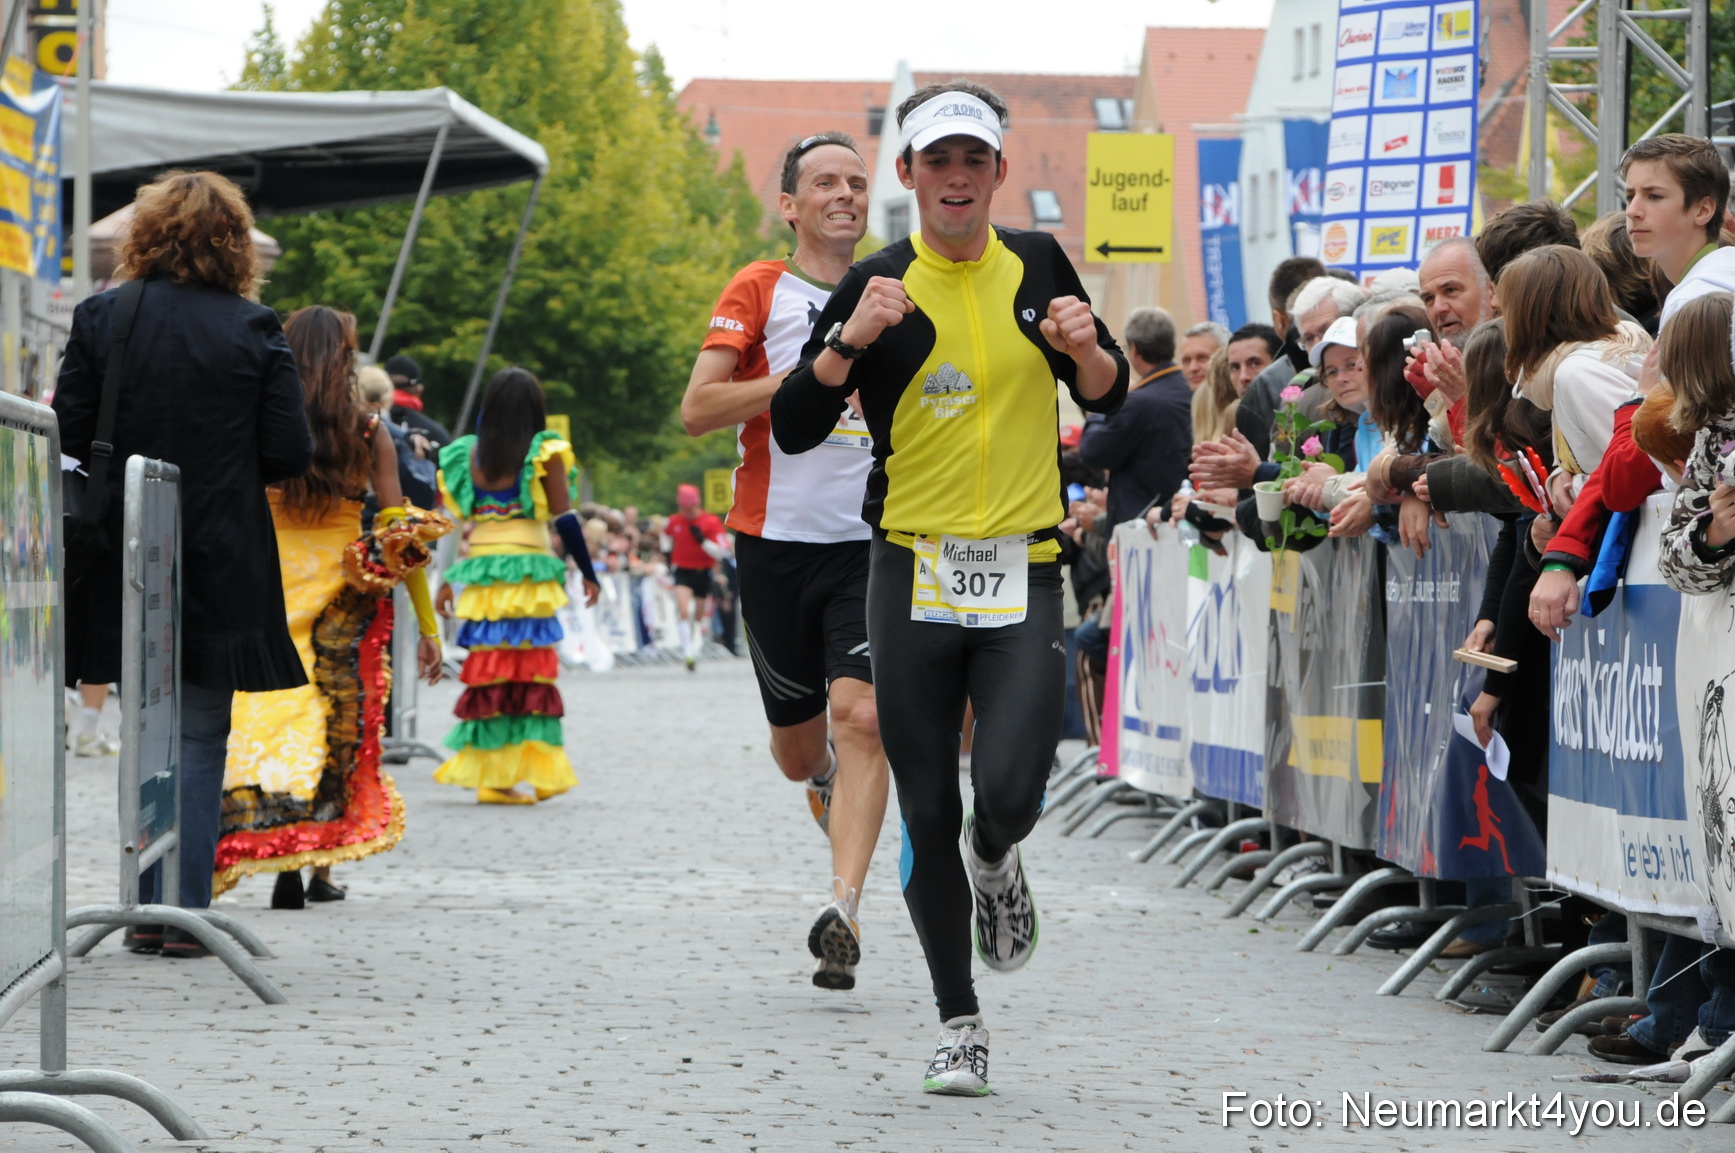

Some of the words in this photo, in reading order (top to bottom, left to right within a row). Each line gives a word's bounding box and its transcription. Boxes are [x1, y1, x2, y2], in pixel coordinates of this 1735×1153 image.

[1090, 168, 1170, 190] Jugend-
[1112, 193, 1149, 211] lauf
[1426, 226, 1461, 241] MERZ
[920, 394, 978, 410] Pyraser
[934, 406, 965, 419] Bier
[943, 542, 998, 562] Michael
[919, 562, 927, 575] A
[951, 570, 1006, 597] 307
[979, 612, 1024, 622] PFLEIDERER
[1668, 834, 1696, 883] ich
